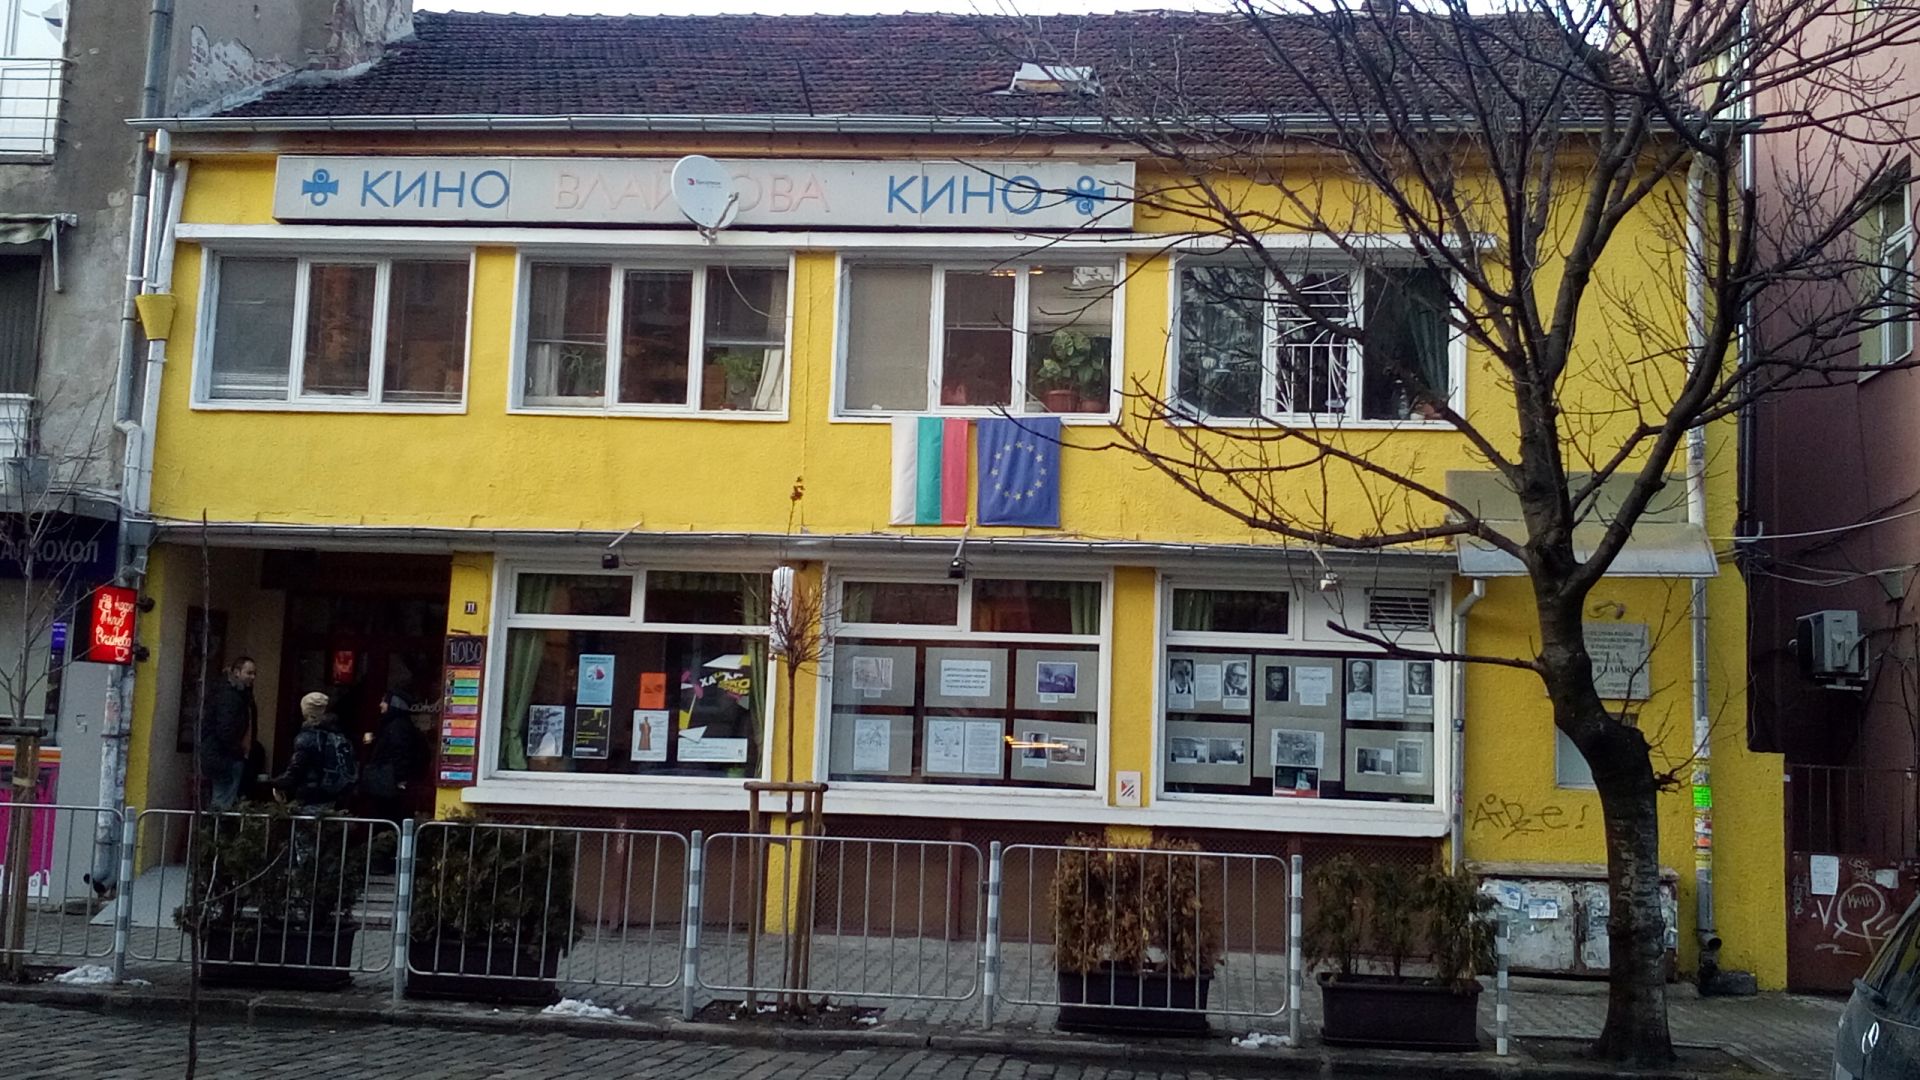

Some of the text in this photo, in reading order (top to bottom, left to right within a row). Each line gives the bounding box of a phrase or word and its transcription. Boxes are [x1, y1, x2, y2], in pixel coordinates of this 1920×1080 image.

[359, 169, 1043, 216] КИНО ВЛАЙОВА КИНО
